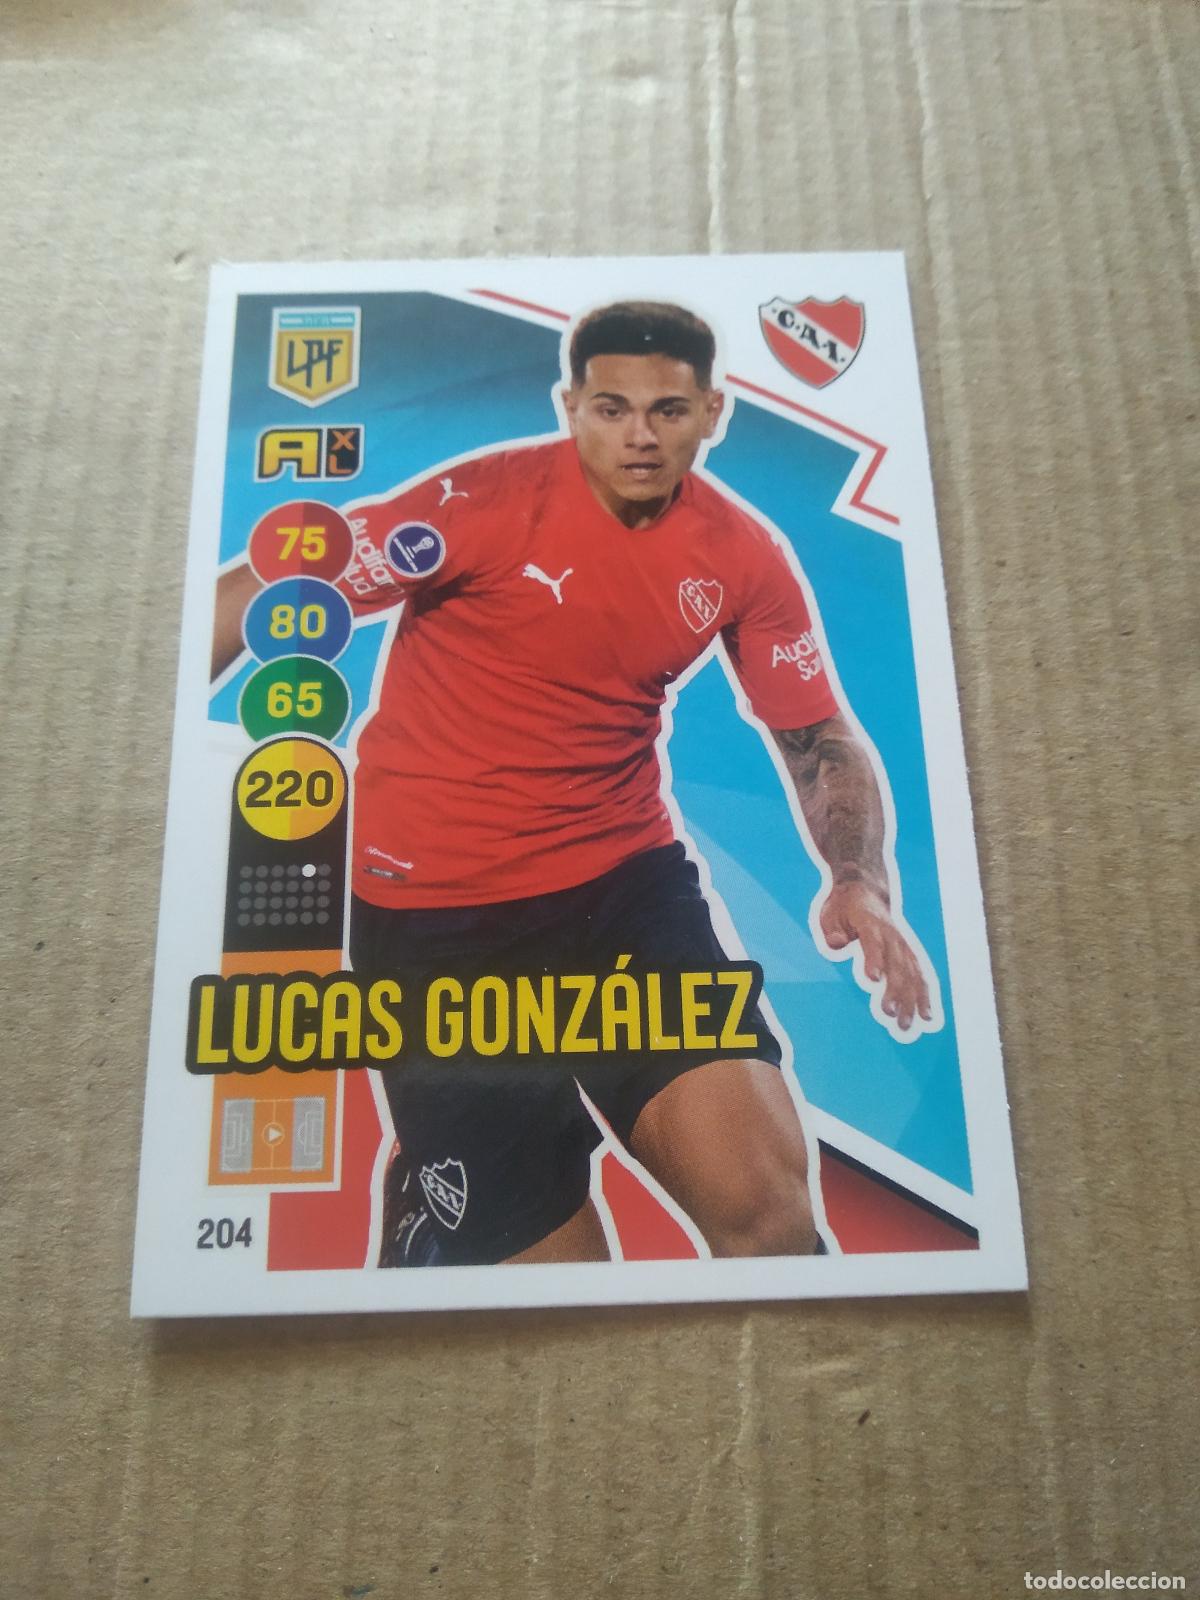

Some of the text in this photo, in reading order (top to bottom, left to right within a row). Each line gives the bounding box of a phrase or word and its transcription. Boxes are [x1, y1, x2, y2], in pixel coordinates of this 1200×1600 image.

[286, 338, 344, 390] LPF
[276, 526, 327, 561] 75
[269, 604, 327, 639] 80
[267, 681, 323, 718] 65
[245, 769, 335, 808] 220
[196, 954, 759, 1064] LUCAS GONZÁLEZ
[196, 1217, 253, 1250] 204
